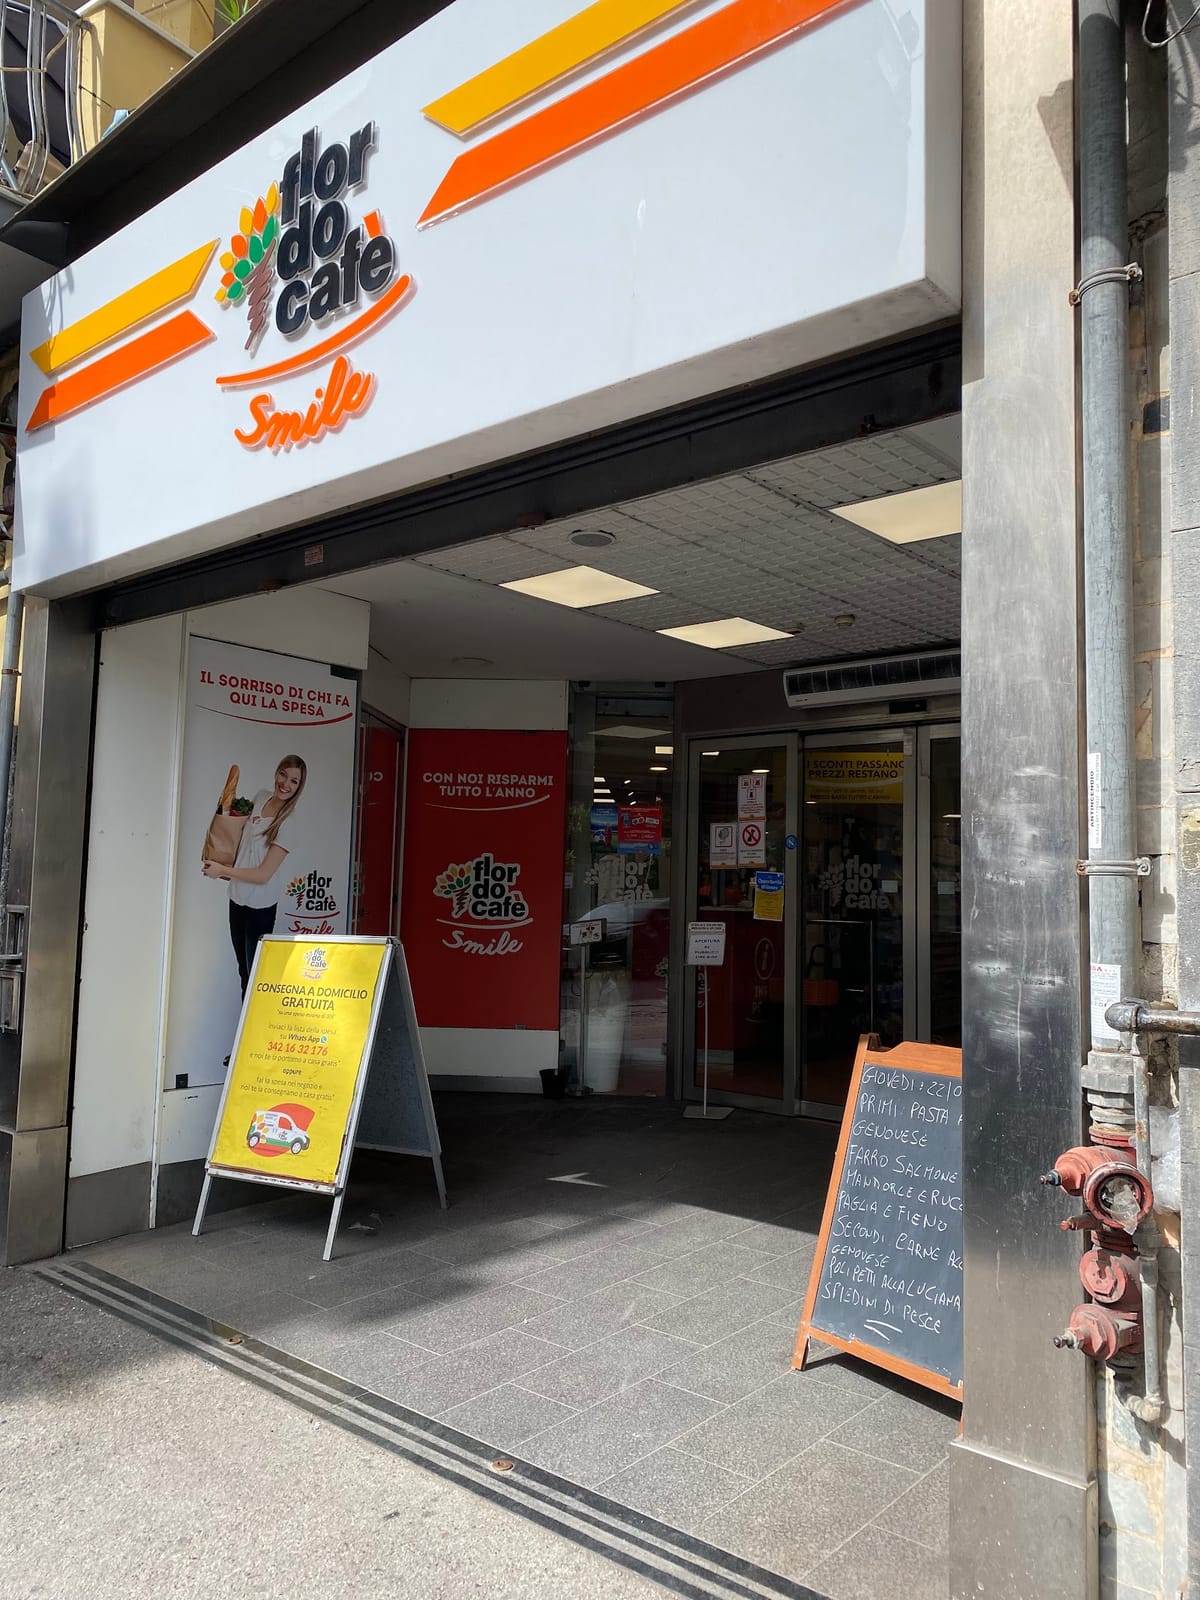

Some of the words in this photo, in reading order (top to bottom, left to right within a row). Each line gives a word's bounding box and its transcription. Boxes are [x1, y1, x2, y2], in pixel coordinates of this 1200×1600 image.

[279, 120, 374, 228] flor
[277, 199, 348, 281] do
[276, 209, 394, 334] cafè
[234, 354, 373, 449] Smile
[200, 670, 214, 684] IL
[218, 674, 284, 696] SORRISO
[288, 686, 303, 699] DI
[307, 690, 332, 704] CHI
[335, 694, 350, 708] FA
[229, 692, 257, 706] QUI
[261, 696, 278, 710] LA
[282, 700, 325, 717] SPESA
[808, 770, 845, 778] PREZZI
[848, 770, 898, 778] RESTANO
[813, 760, 853, 769] SCONTI
[422, 772, 454, 784] CON
[457, 773, 484, 785] NOI
[487, 774, 554, 786] RISPARMI
[439, 785, 482, 797] TUTTO
[485, 786, 536, 798] L'ANNO
[472, 856, 518, 882] flor
[844, 854, 882, 879] flor
[307, 870, 332, 888] flor
[472, 877, 506, 899] do
[844, 873, 873, 894] do
[305, 895, 337, 911] cafè
[306, 885, 325, 899] do
[471, 893, 526, 917] cafè
[288, 920, 335, 935] Smile
[441, 930, 524, 956] Smile
[311, 954, 322, 962] do
[256, 982, 305, 995] CONSEGNA
[307, 986, 315, 996] A
[317, 987, 368, 1000] DOMICILIO
[281, 996, 335, 1011] GRATUITA
[267, 1041, 283, 1052] 342
[286, 1043, 295, 1053] 16
[297, 1044, 309, 1055] 32
[311, 1046, 328, 1056] 176
[288, 1033, 307, 1042] Whats
[308, 1035, 320, 1043] App
[282, 1067, 302, 1075] oppure
[297, 1082, 318, 1090] negozio
[910, 1101, 949, 1126] PASTA
[852, 1119, 928, 1147] GENOVESE
[847, 1144, 889, 1168] FARRO
[892, 1155, 958, 1184] SALMONE
[846, 1168, 914, 1198] MANDORLE
[917, 1190, 928, 1203] E
[838, 1190, 878, 1214] PAGLIA
[883, 1204, 893, 1218] E
[898, 1205, 948, 1232] FIENO
[831, 1243, 891, 1268] GENOVESE
[895, 1232, 941, 1261] CARNE
[821, 1281, 878, 1309] SPIEDINI
[883, 1298, 895, 1316] DI
[903, 1304, 943, 1334] PESCE
